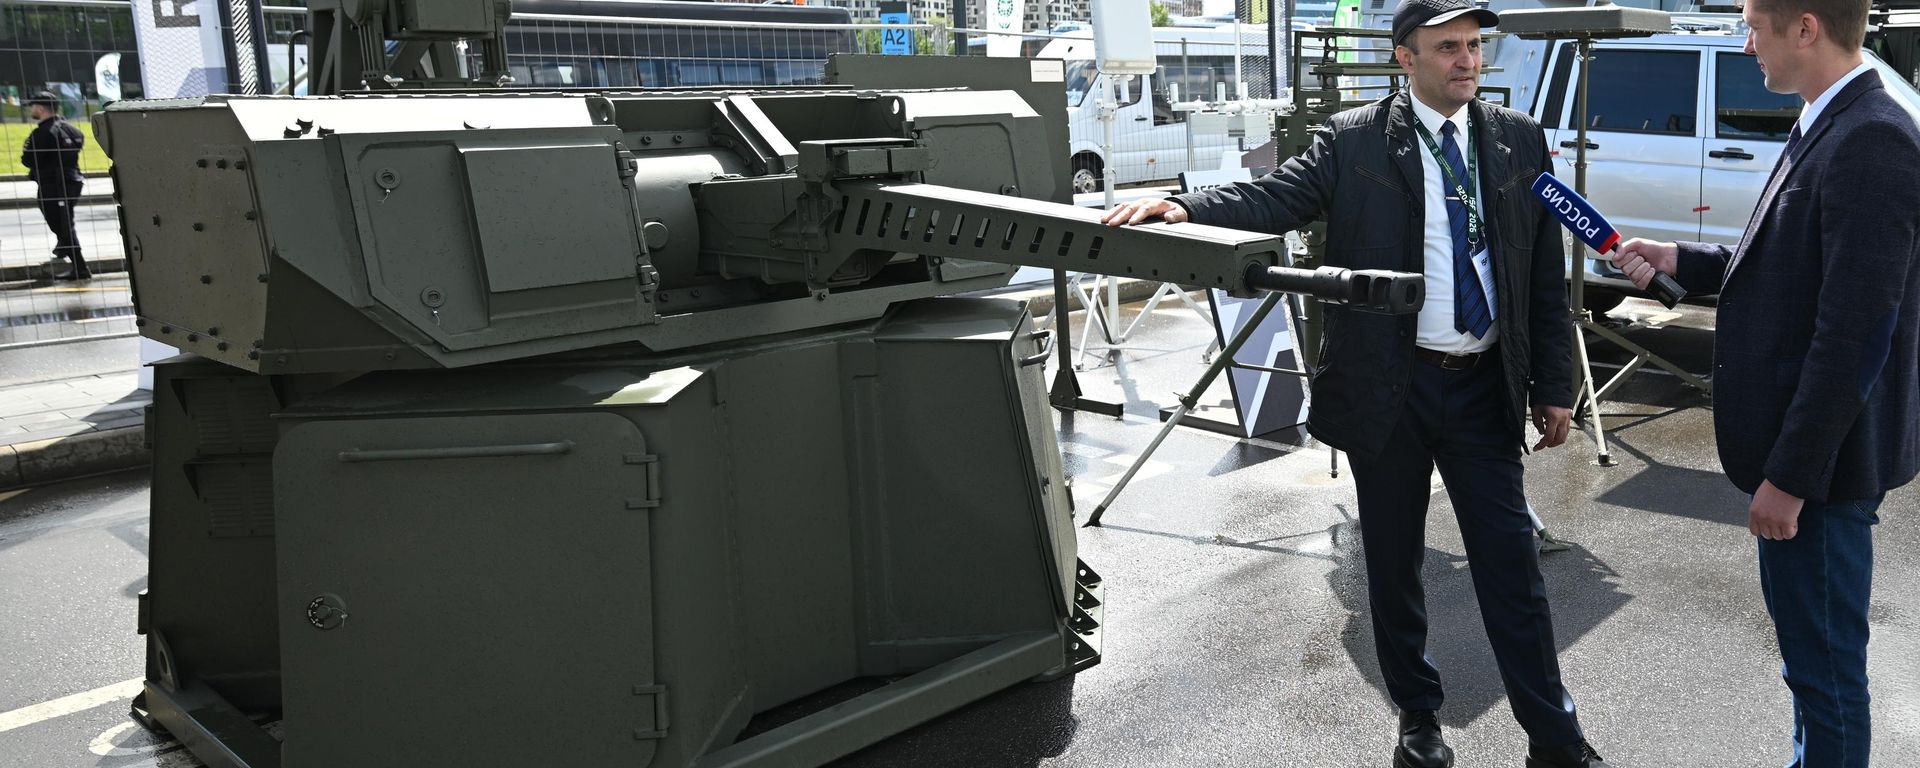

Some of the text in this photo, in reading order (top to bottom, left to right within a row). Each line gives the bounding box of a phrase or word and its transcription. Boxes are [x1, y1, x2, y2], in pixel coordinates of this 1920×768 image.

[885, 28, 905, 45] A2
[1541, 183, 1600, 239] РОССИЯ
[1469, 213, 1477, 233] 2026
